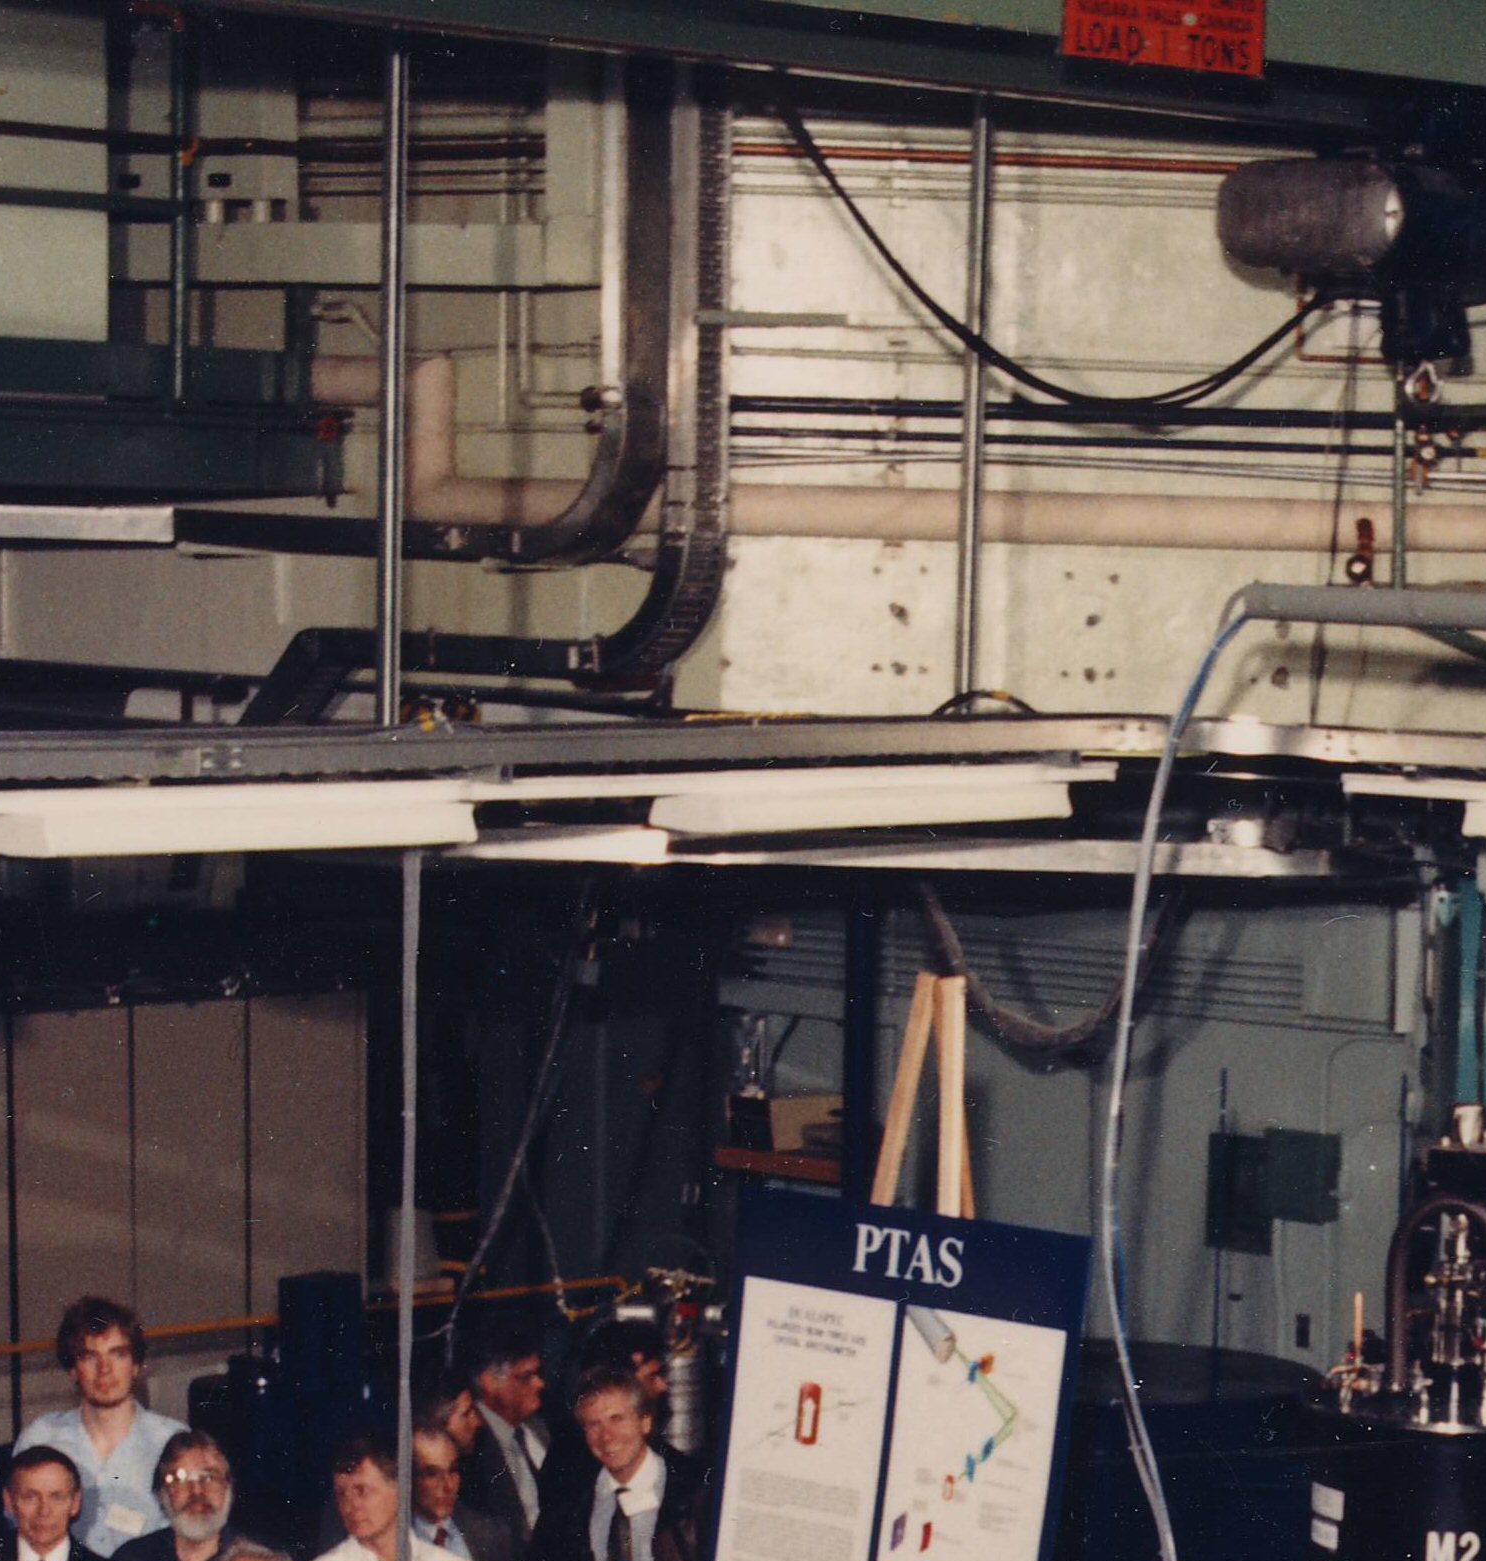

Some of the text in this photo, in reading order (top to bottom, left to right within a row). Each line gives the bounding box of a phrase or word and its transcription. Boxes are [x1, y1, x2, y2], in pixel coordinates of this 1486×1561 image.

[1075, 20, 1145, 58] LOAD
[1186, 33, 1251, 71] TONS
[852, 1223, 965, 1289] PTAS
